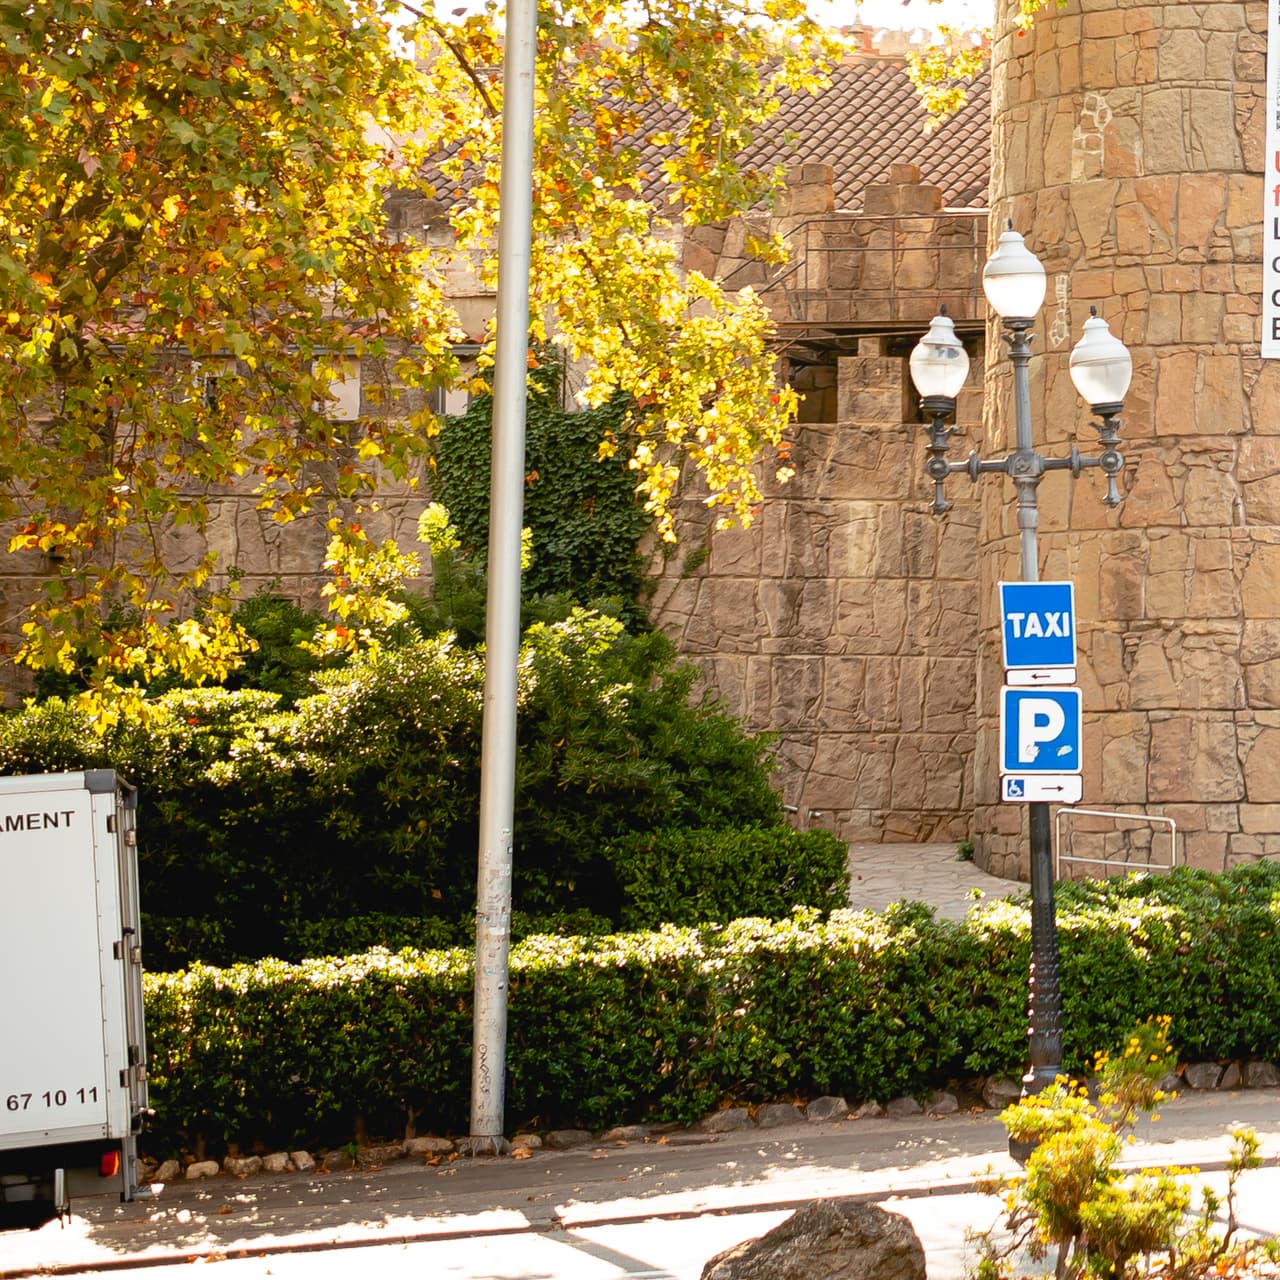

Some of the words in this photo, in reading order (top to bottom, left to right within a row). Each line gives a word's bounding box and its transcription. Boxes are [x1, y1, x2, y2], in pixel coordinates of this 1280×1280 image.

[1007, 612, 1070, 638] TAXI
[1018, 698, 1066, 763] P
[0, 810, 75, 832] MENT
[6, 1093, 33, 1111] 67
[42, 1090, 67, 1107] 10
[76, 1086, 98, 1104] 11
